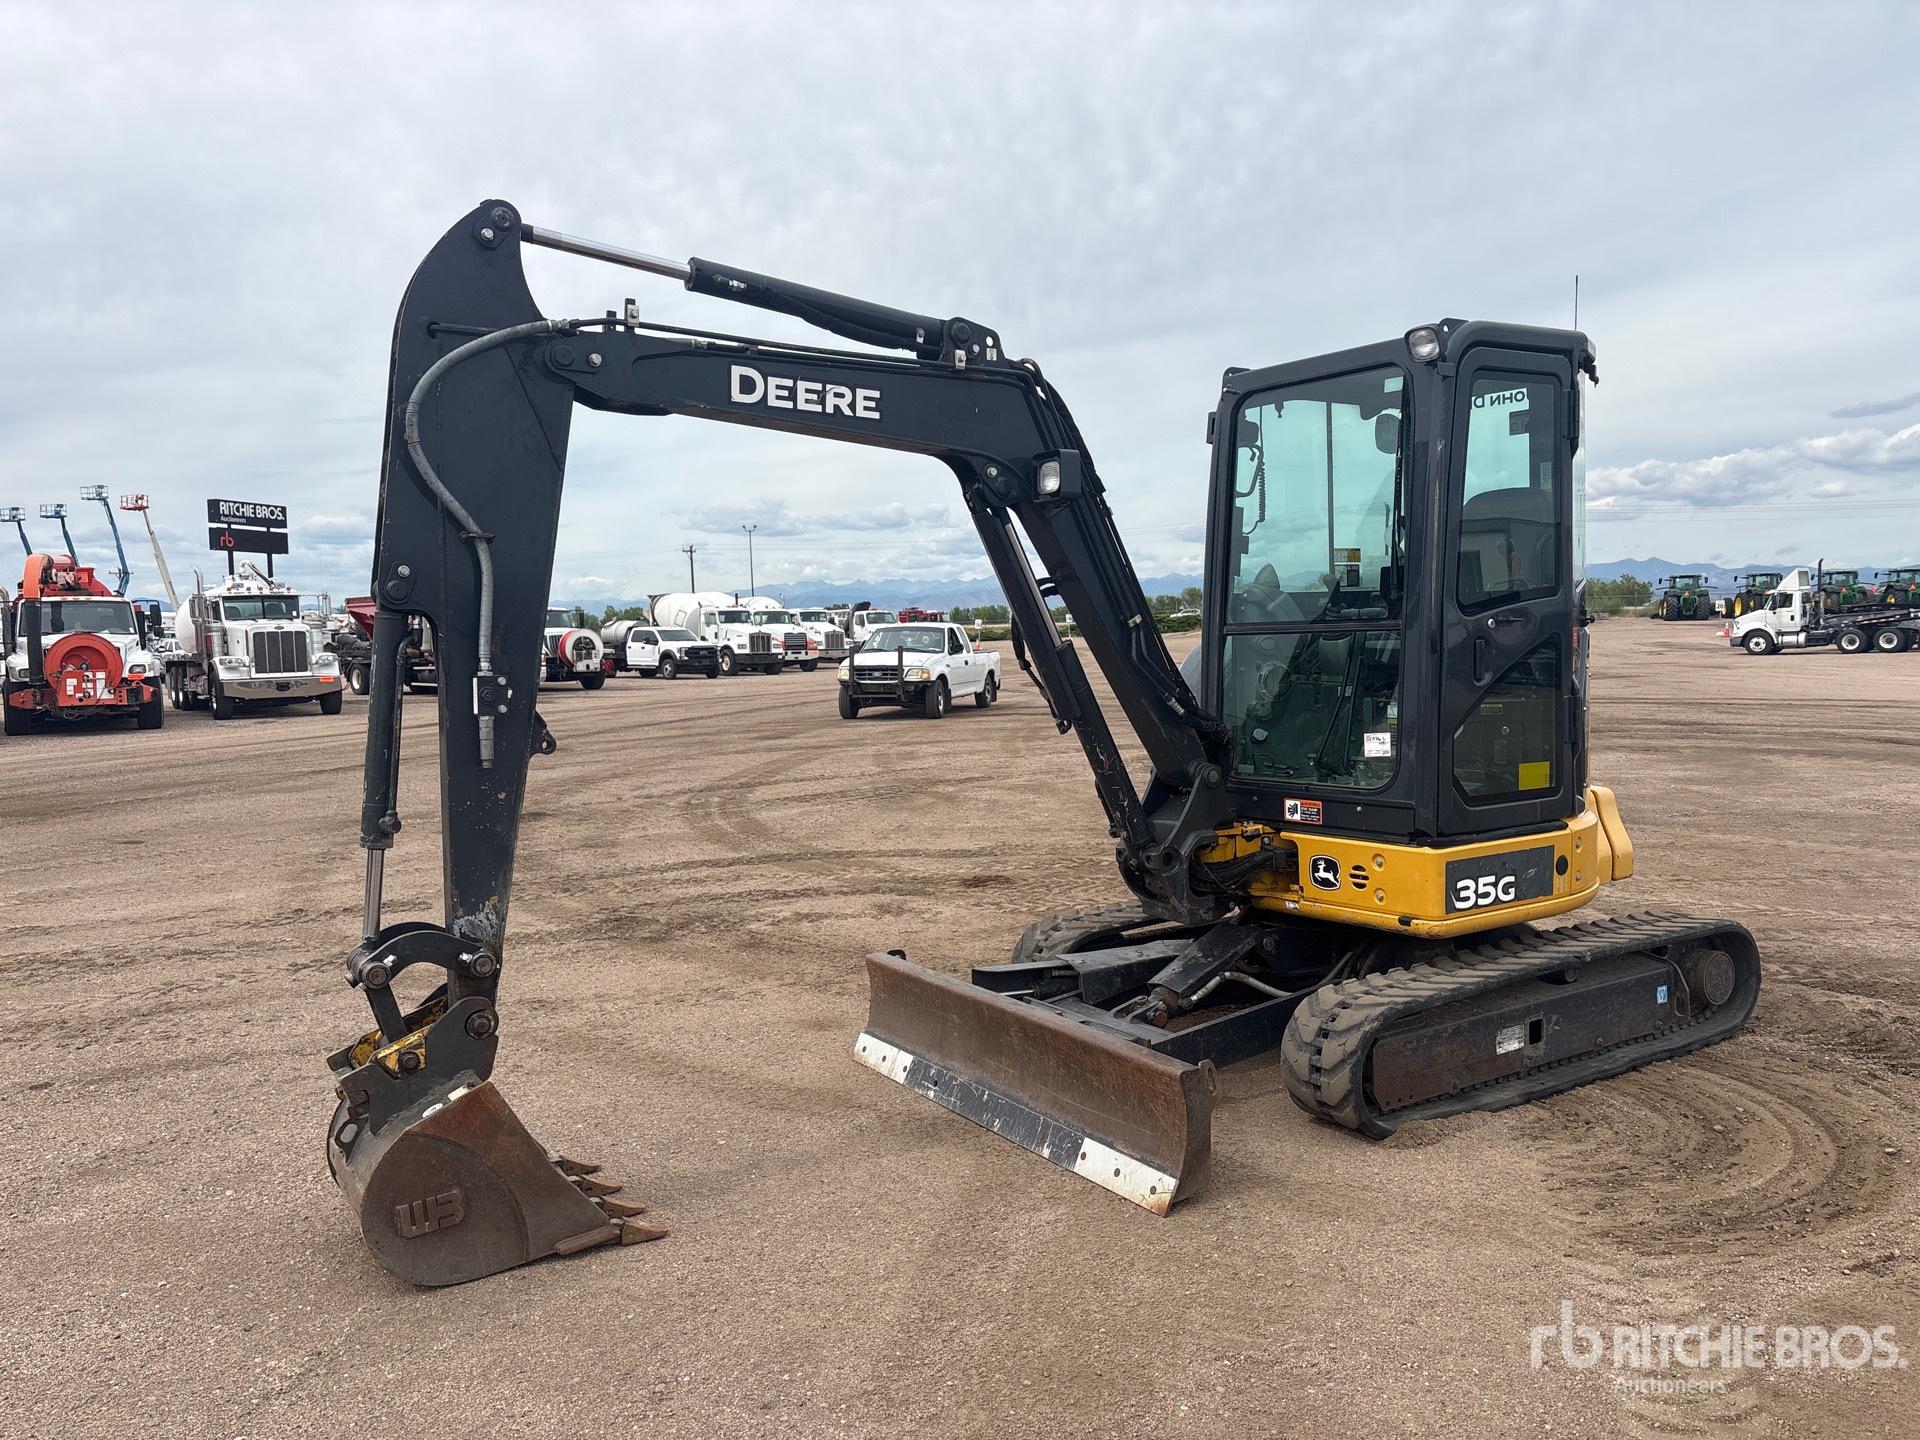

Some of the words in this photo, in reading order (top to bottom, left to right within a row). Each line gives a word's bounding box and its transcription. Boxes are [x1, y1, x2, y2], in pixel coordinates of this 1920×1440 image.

[730, 364, 881, 420] DEERE
[220, 501, 254, 517] RITCHIE
[256, 505, 284, 520] BROS.
[220, 531, 235, 547] rb
[1451, 875, 1515, 909] 35G
